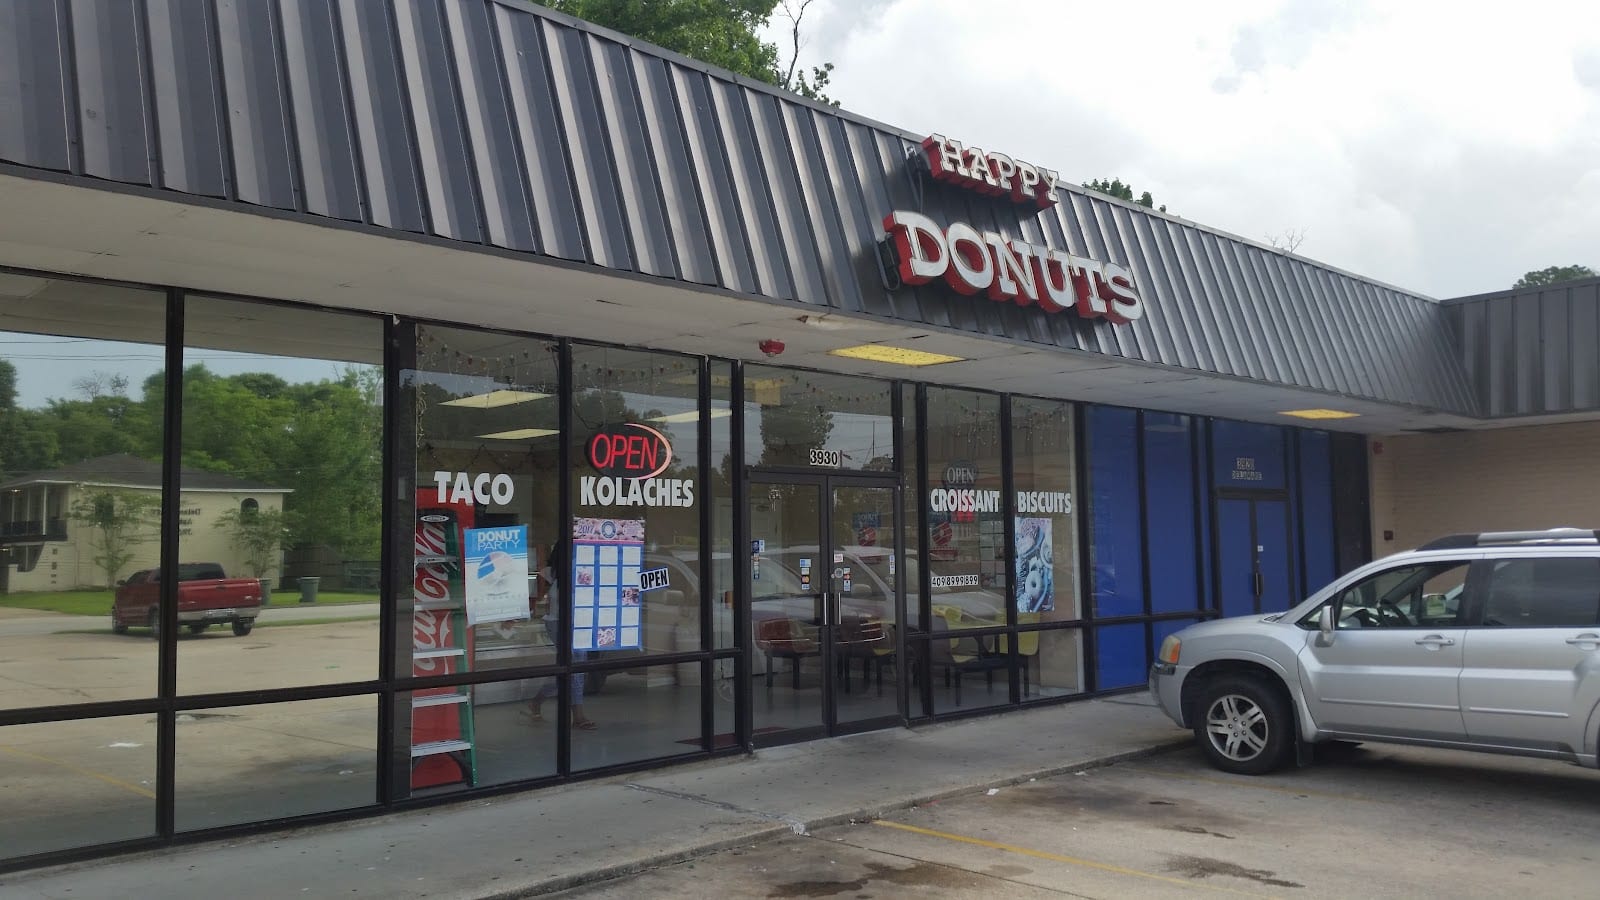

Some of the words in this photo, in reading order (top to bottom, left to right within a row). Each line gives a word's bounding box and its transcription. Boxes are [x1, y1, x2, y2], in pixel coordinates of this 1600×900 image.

[926, 133, 1059, 203] HAPPY
[890, 209, 1144, 321] DONUTS
[591, 433, 660, 470] OPEN
[810, 449, 838, 466] 3930
[946, 466, 976, 484] OPEN
[433, 471, 514, 506] TACO
[580, 475, 694, 508] KOLACHES
[930, 488, 1000, 513] CROISSANT
[1017, 491, 1072, 514] BISCUITS
[477, 529, 520, 545] DONUT
[477, 540, 520, 551] PARTY
[640, 569, 668, 590] OPEN
